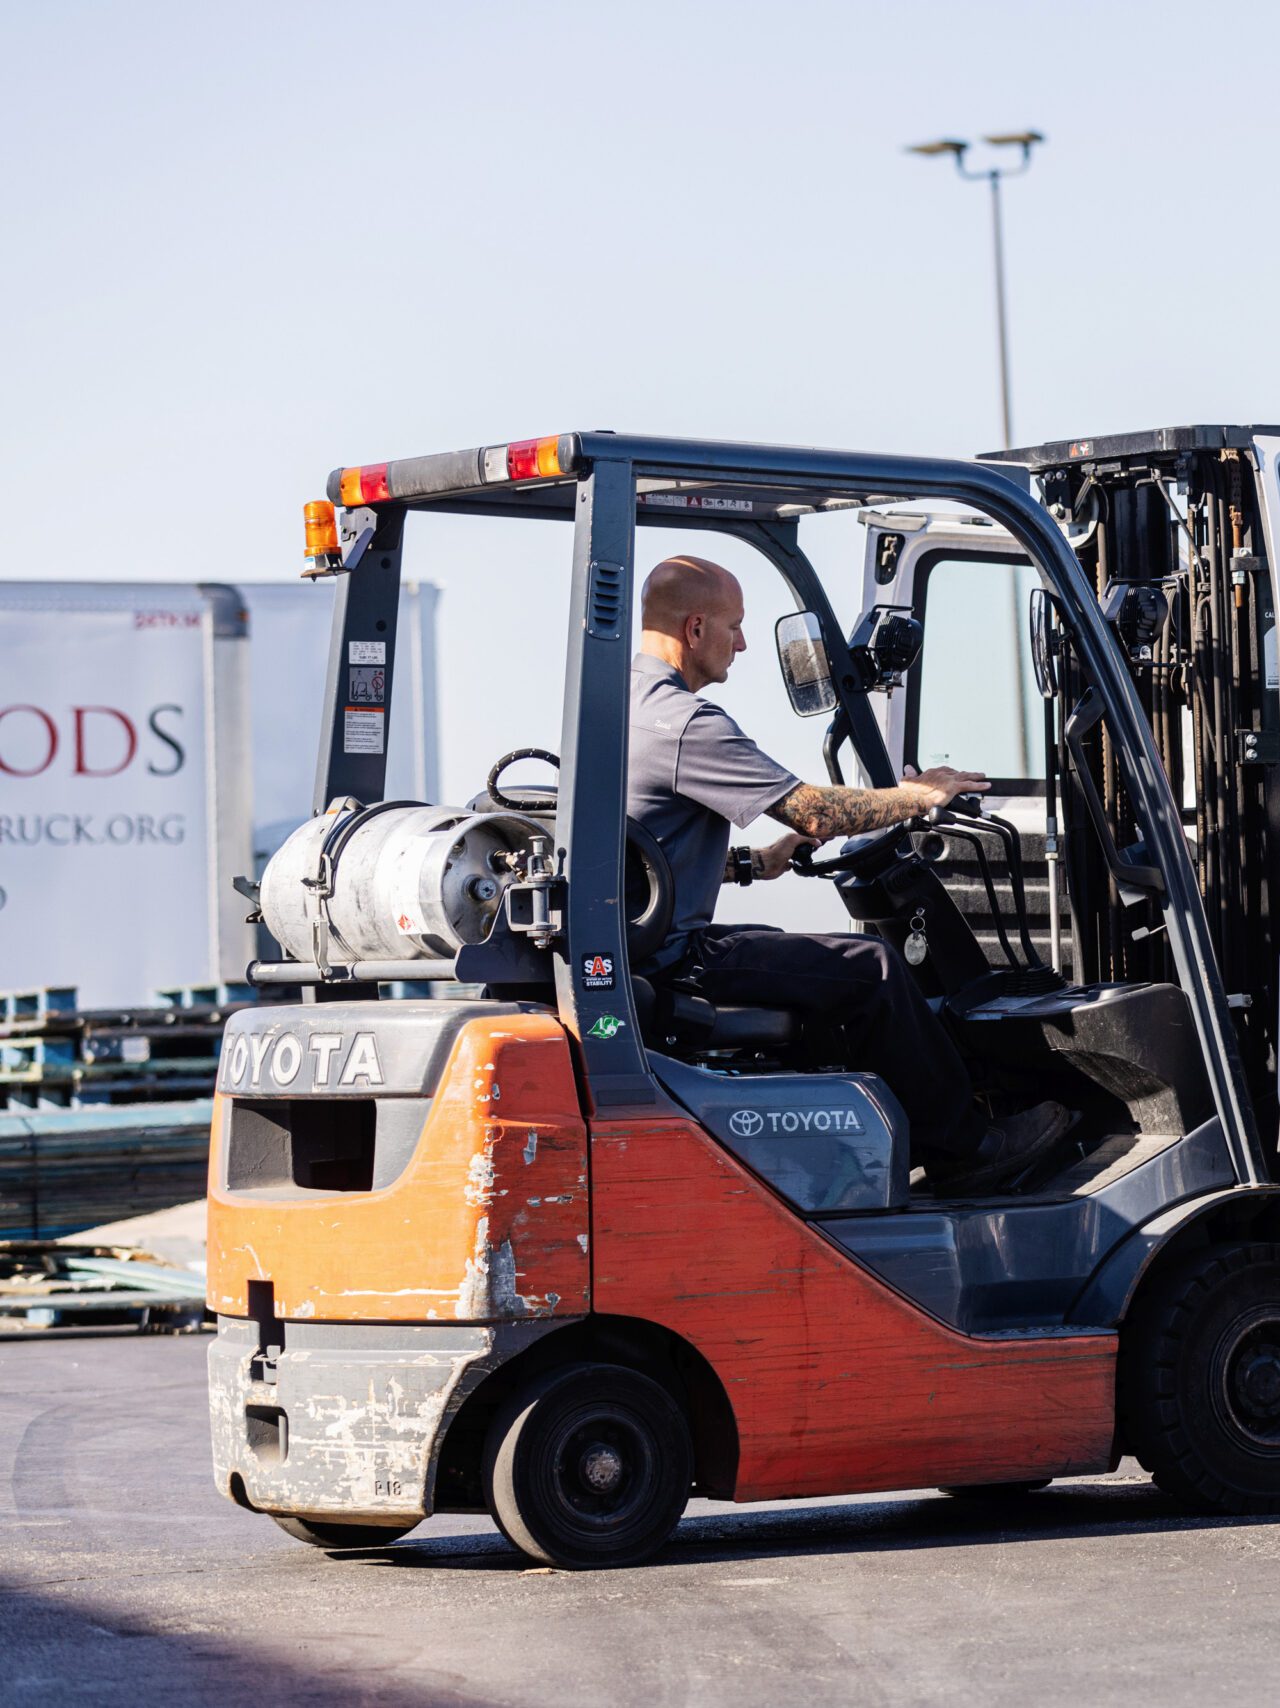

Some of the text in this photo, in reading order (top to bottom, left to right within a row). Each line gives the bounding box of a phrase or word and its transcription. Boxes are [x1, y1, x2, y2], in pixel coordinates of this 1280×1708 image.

[0, 703, 186, 777] ODS
[584, 956, 613, 977] SAS
[219, 1032, 385, 1088] TOYOTA
[767, 1110, 862, 1132] TOYOTA
